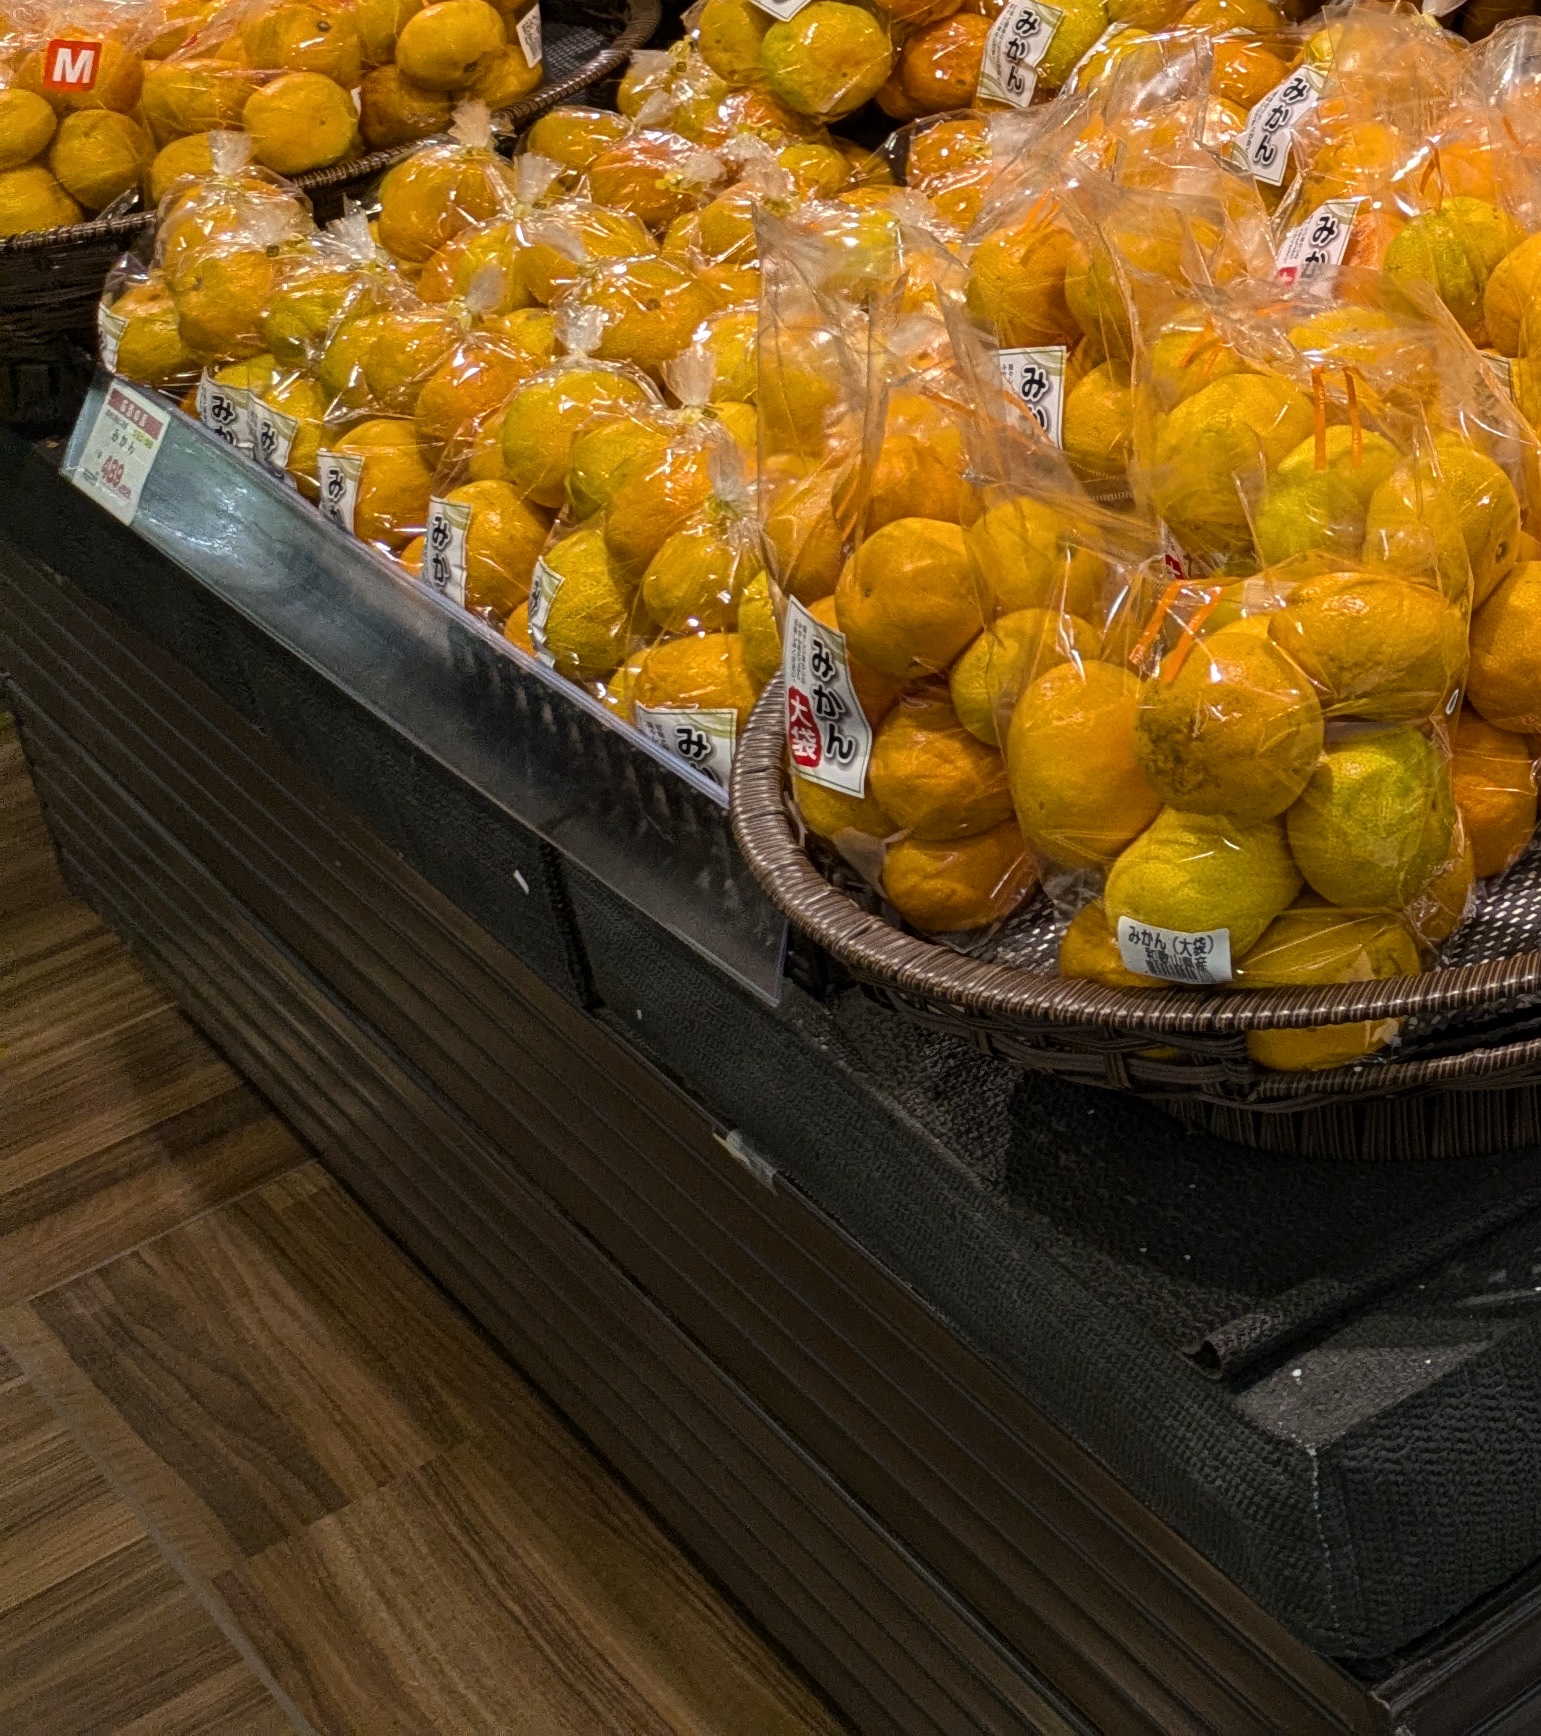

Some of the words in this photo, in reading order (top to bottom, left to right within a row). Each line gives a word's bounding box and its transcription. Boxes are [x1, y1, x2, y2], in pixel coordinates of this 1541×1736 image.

[53, 47, 96, 84] M
[1003, 10, 1042, 94] みかん
[1257, 75, 1310, 166] みかん
[109, 428, 136, 455] みかん
[789, 690, 819, 765] 大袋
[810, 638, 854, 761] みかん
[1127, 924, 1214, 956] みかん（大袋）
